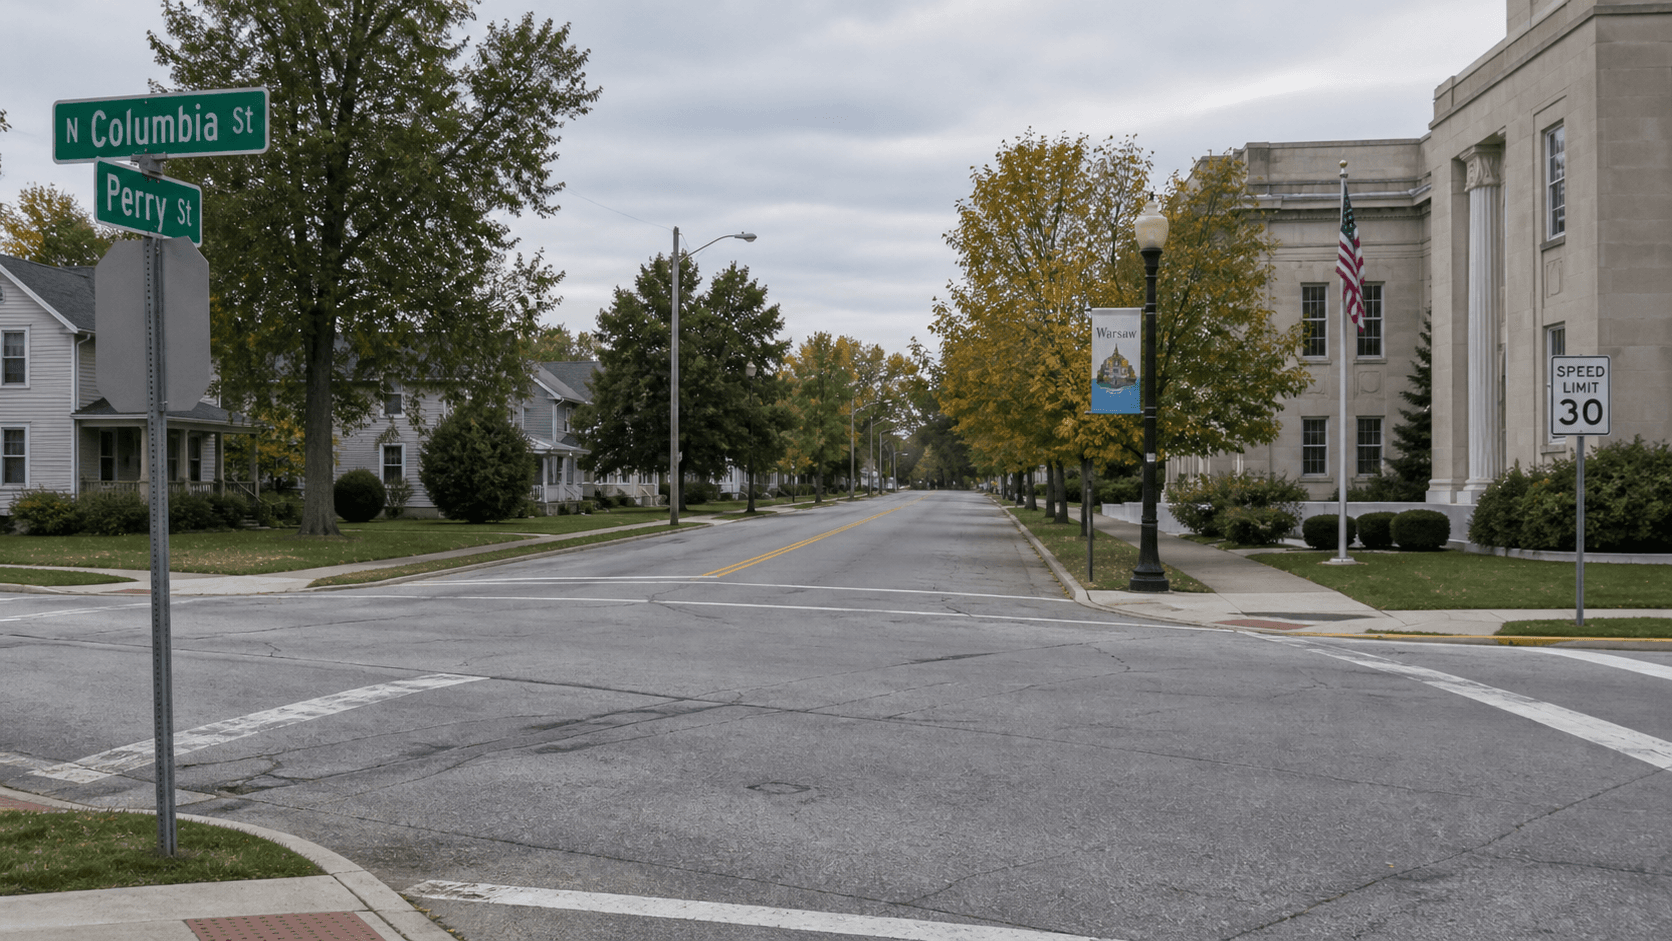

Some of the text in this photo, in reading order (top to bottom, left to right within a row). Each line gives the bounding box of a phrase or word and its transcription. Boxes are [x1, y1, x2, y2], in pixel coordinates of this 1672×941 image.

[67, 104, 253, 148] N Columbia St
[107, 173, 192, 233] Perry St
[1096, 327, 1137, 339] Warsaw
[1557, 366, 1605, 377] SPEED
[1563, 382, 1599, 393] LIMIT
[1559, 399, 1603, 425] 30
